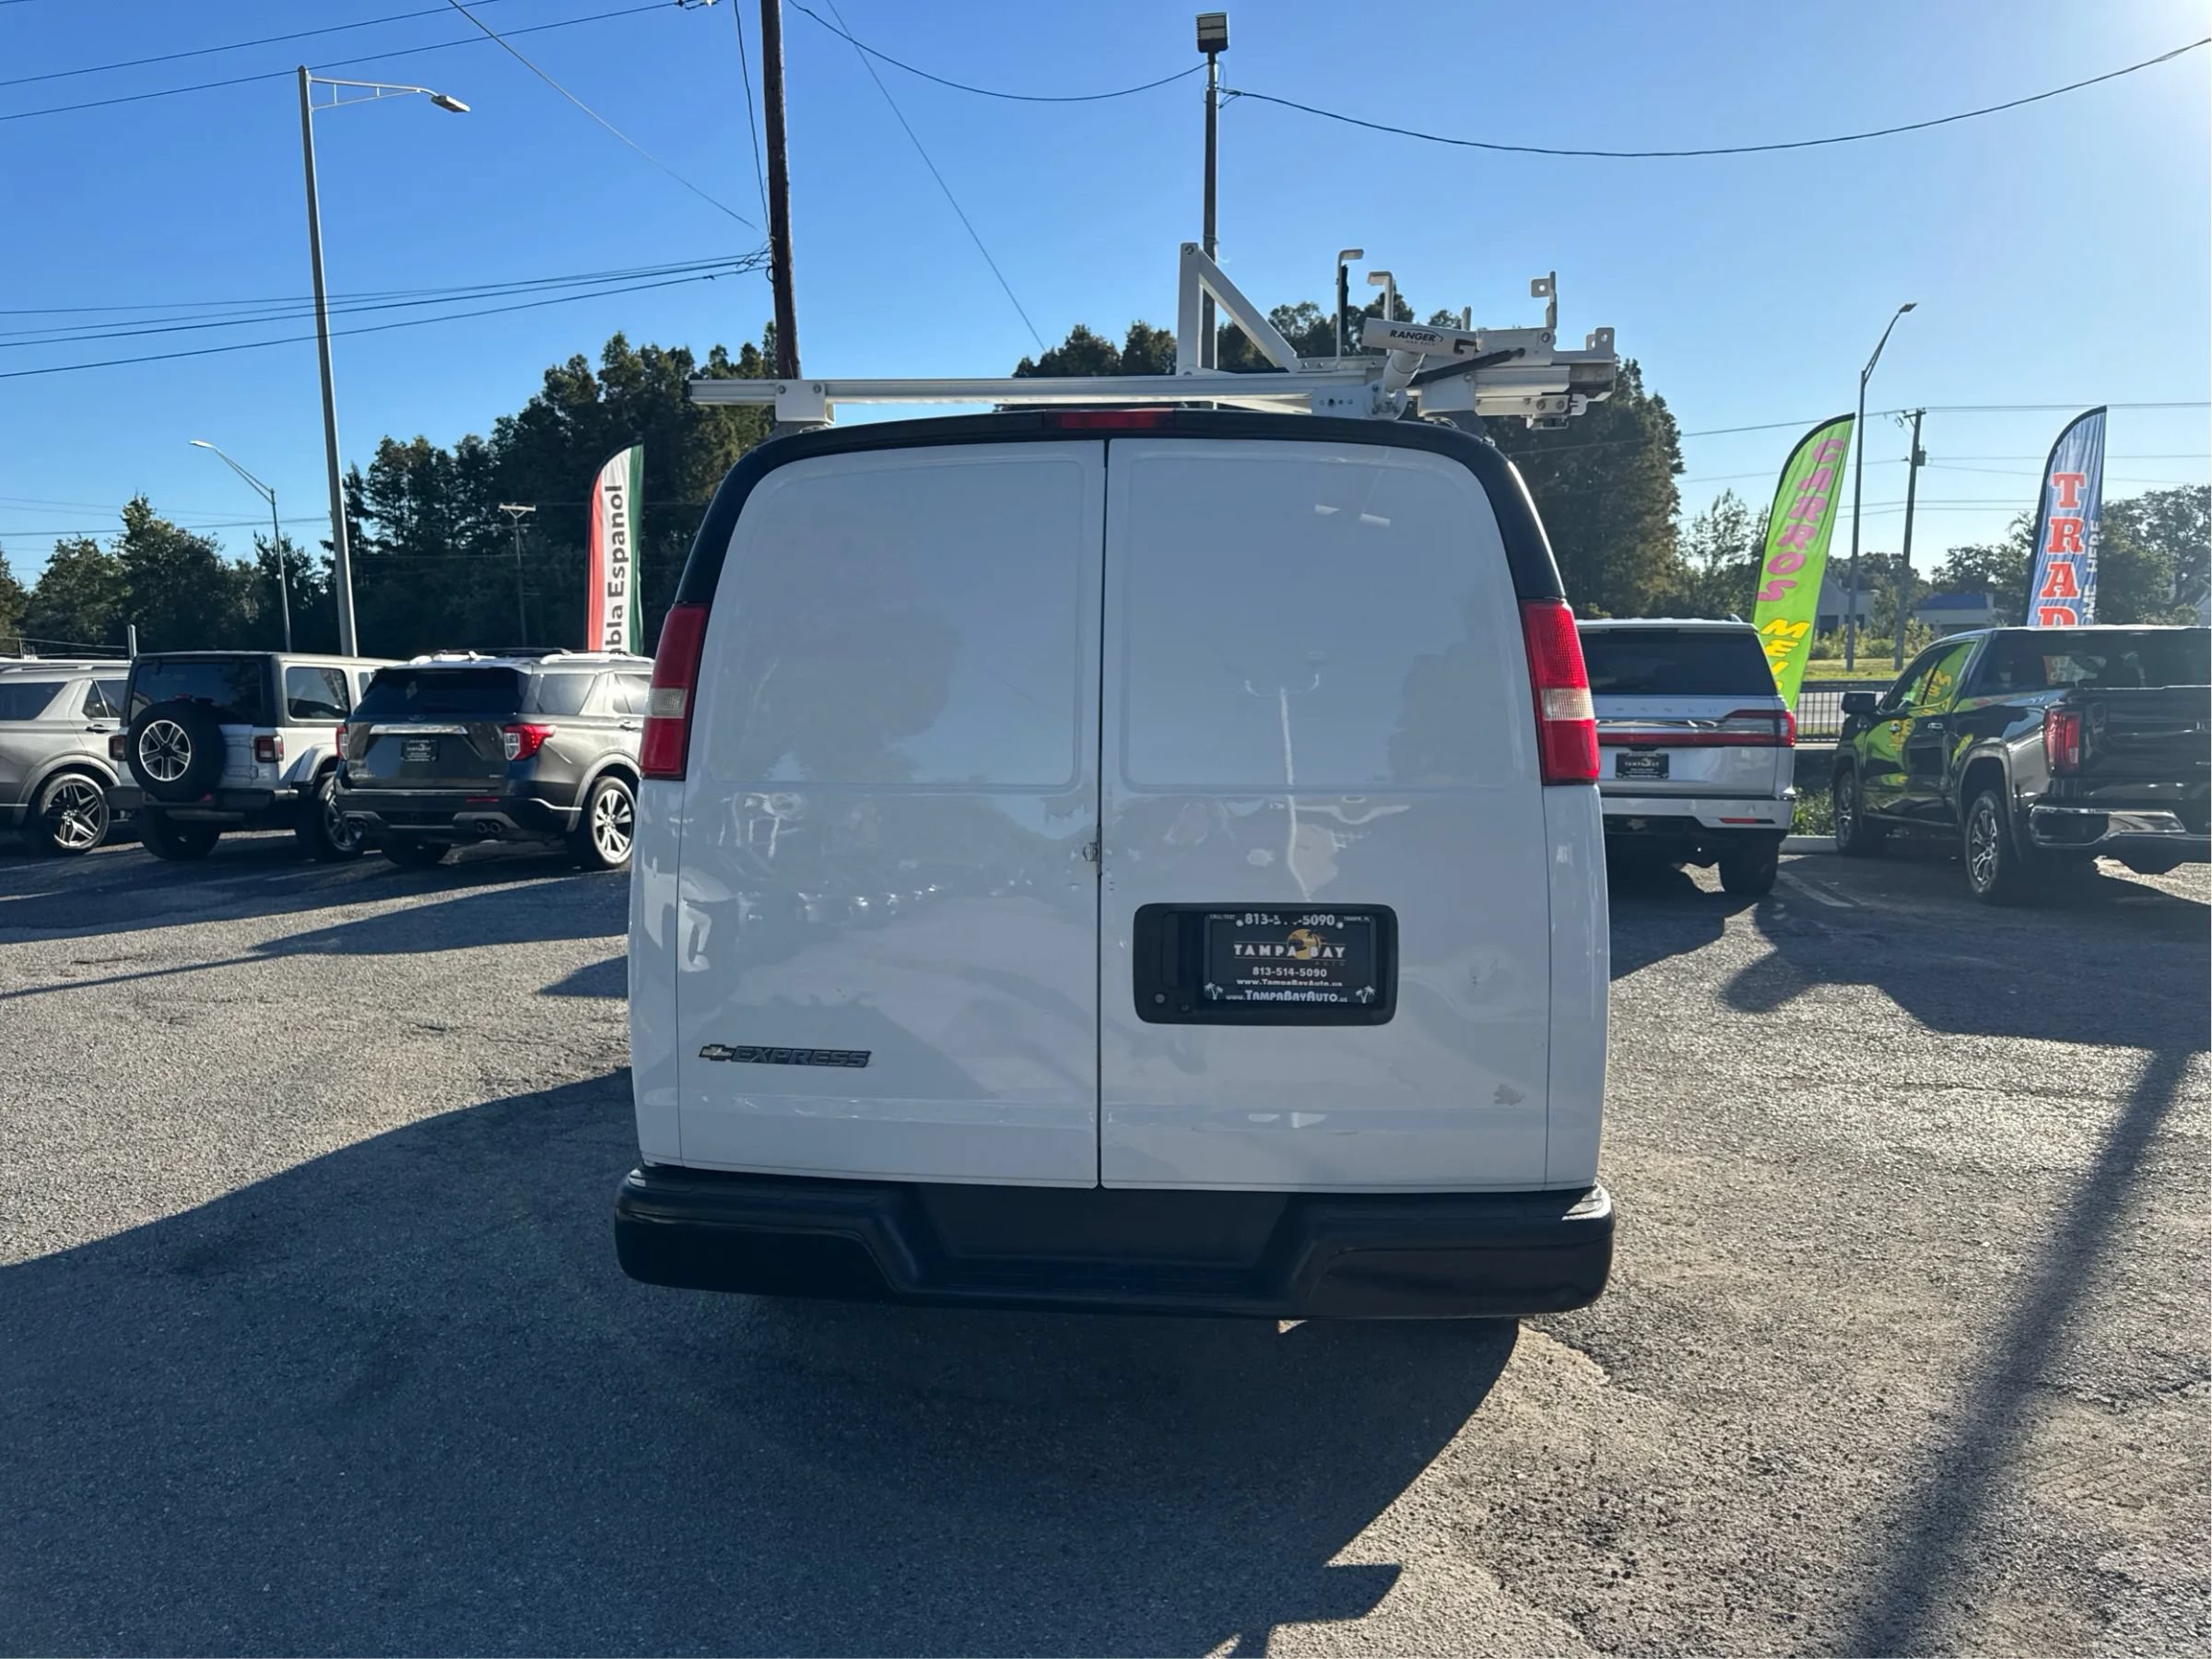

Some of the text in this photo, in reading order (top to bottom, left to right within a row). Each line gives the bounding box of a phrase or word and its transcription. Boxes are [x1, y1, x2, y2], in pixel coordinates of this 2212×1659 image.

[1390, 329, 1436, 342] RANGER
[1757, 439, 1843, 602] CARROS
[605, 485, 629, 598] Espanol
[1244, 912, 1335, 926] 813-5-5090
[1234, 944, 1346, 959] TAMPA BAY
[1253, 967, 1327, 978] 813-514-5090
[732, 1046, 871, 1067] EXPRESS
